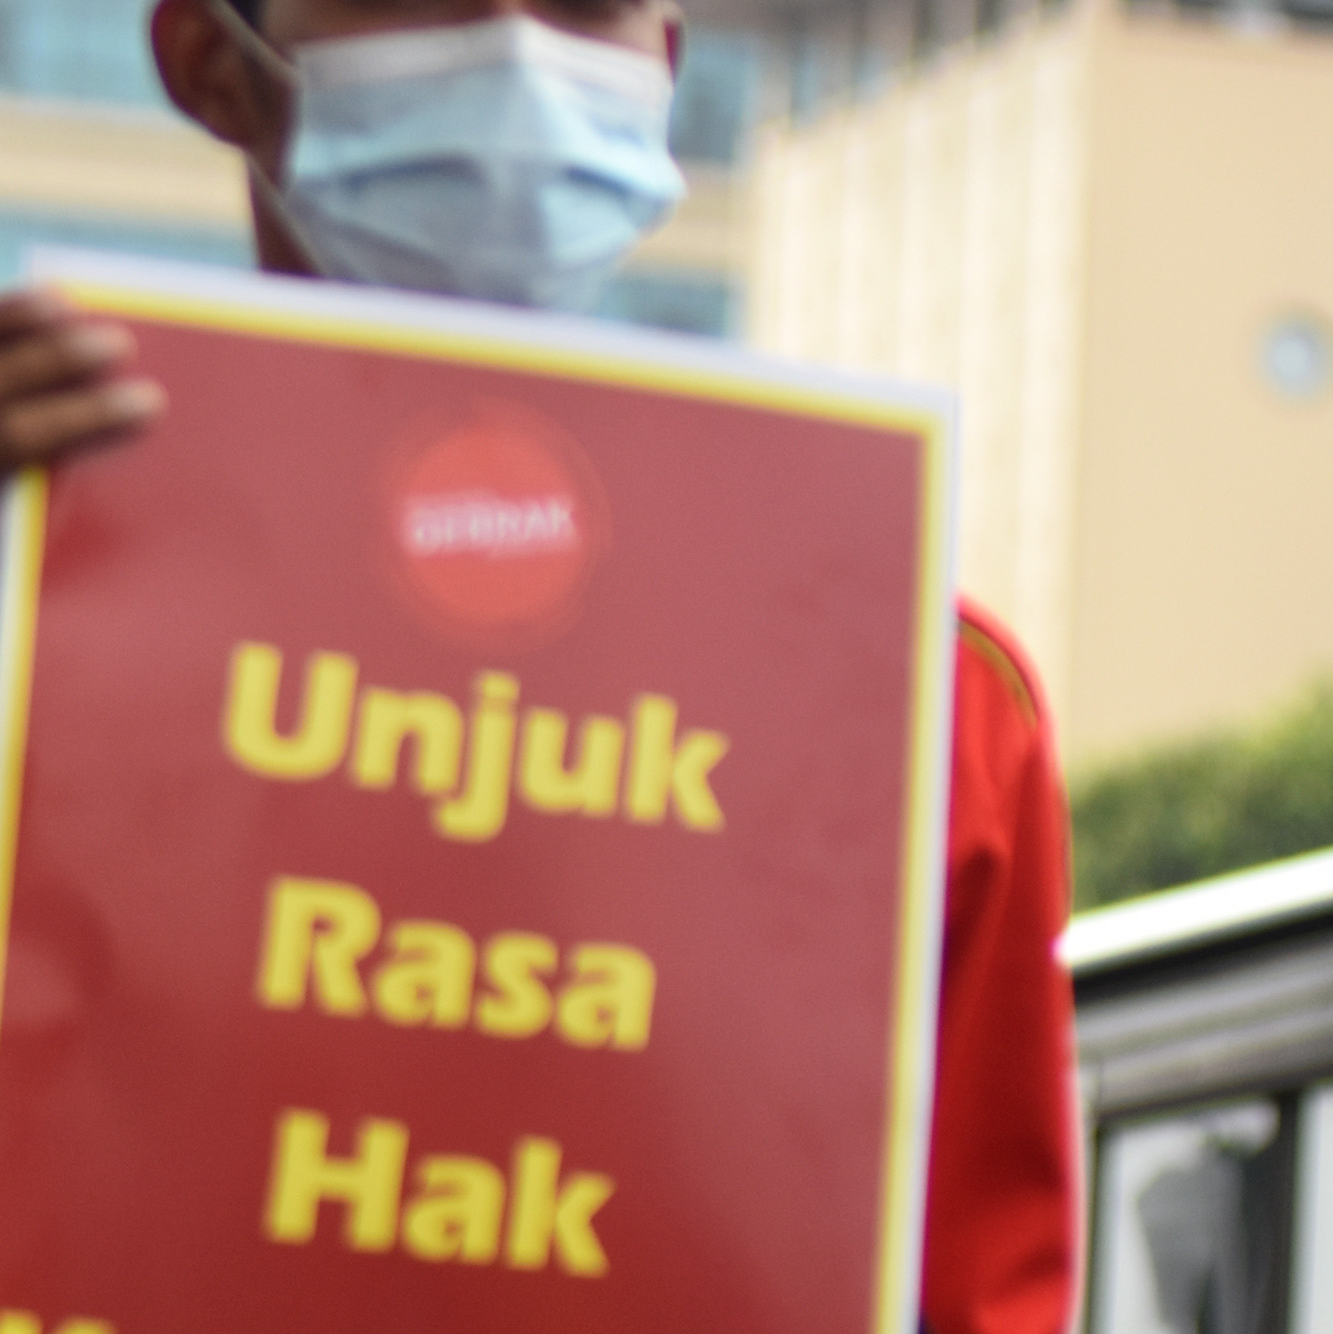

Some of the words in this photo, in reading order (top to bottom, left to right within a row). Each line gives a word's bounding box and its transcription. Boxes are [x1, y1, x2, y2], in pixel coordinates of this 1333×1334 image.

[224, 643, 726, 840] Unjuk
[259, 878, 656, 1049] Rasa
[266, 1110, 613, 1276] Hak
